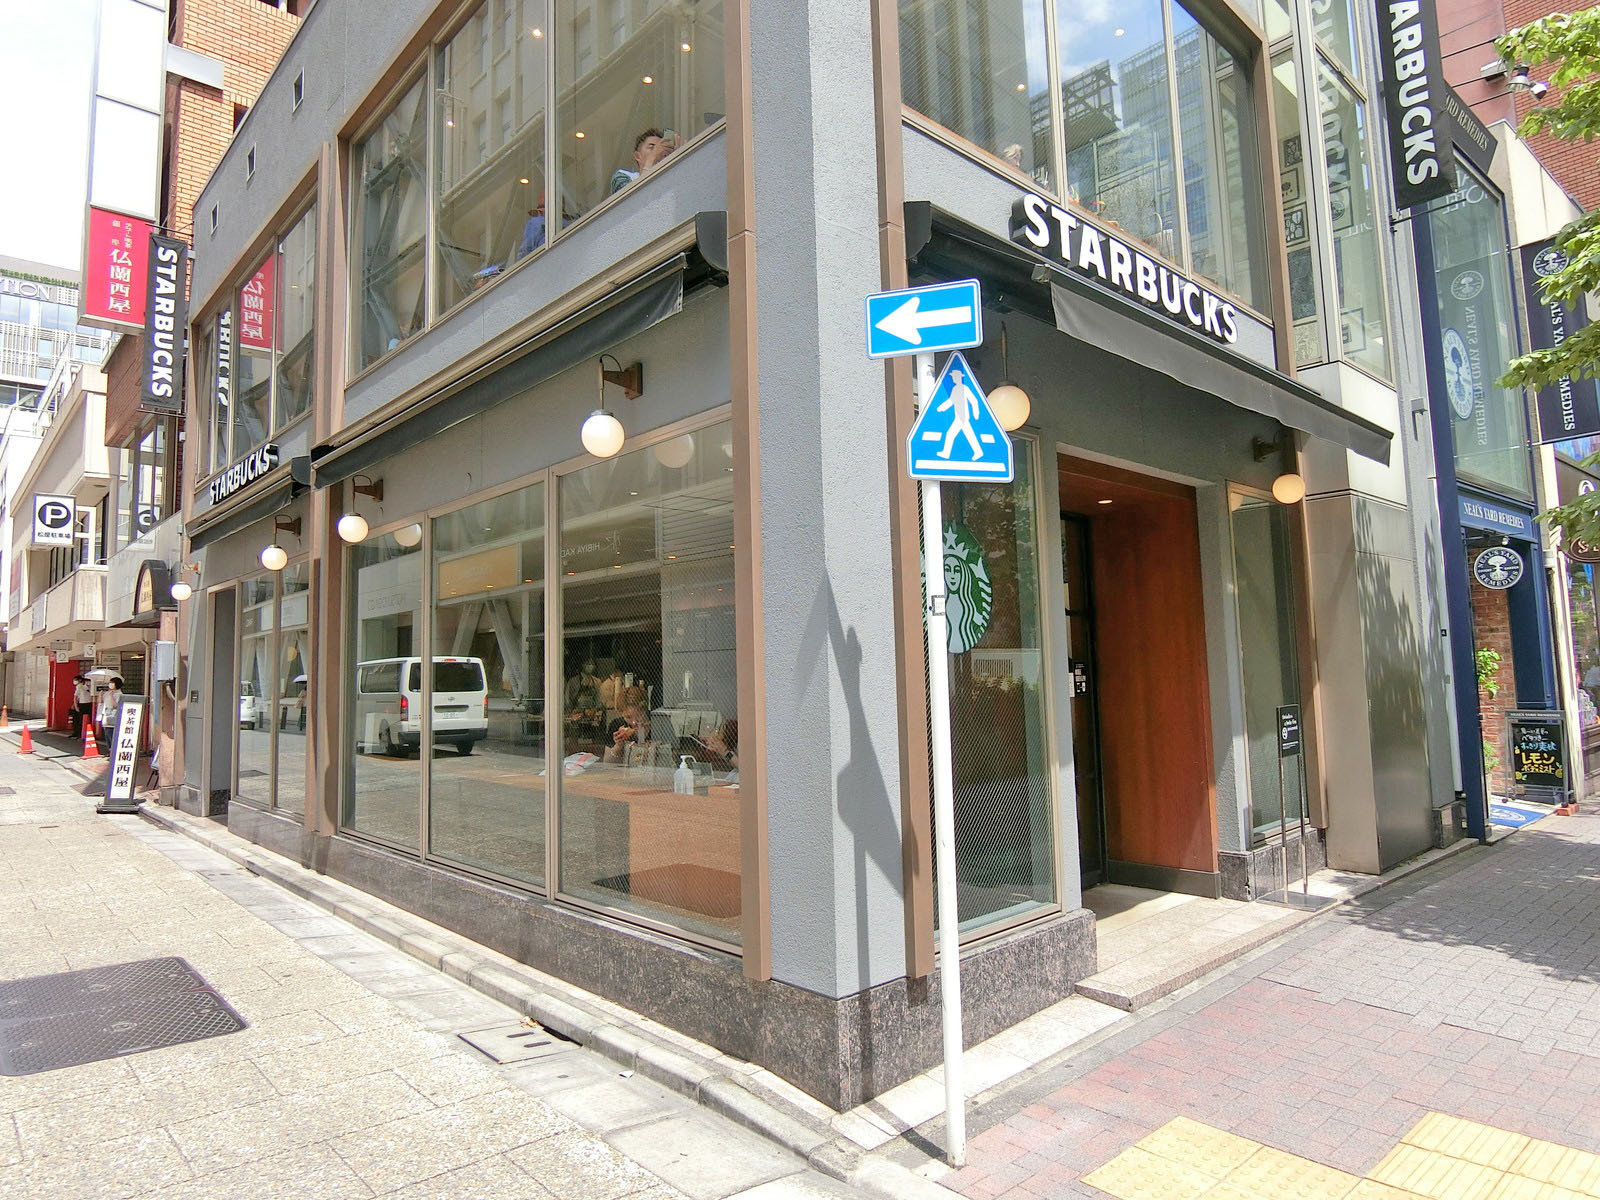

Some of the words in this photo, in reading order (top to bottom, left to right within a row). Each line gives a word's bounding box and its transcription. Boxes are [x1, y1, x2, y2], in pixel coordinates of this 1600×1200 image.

[1457, 108, 1488, 152] REMEDIES
[108, 248, 133, 315] 仏蘭西屋
[1023, 192, 1239, 345] STARBUCKS
[152, 246, 178, 398] STARBUCKS
[208, 443, 272, 506] STARBUCKS
[1464, 502, 1483, 519] NEAL'S
[1483, 507, 1498, 521] YARD
[1498, 511, 1524, 529] REMEDIES
[1478, 550, 1499, 568] NEAL'S
[1500, 550, 1519, 565] YARD
[1480, 570, 1519, 586] REMEDIES
[114, 738, 134, 788] 仏蘭西屋
[1521, 752, 1555, 764] レモン
